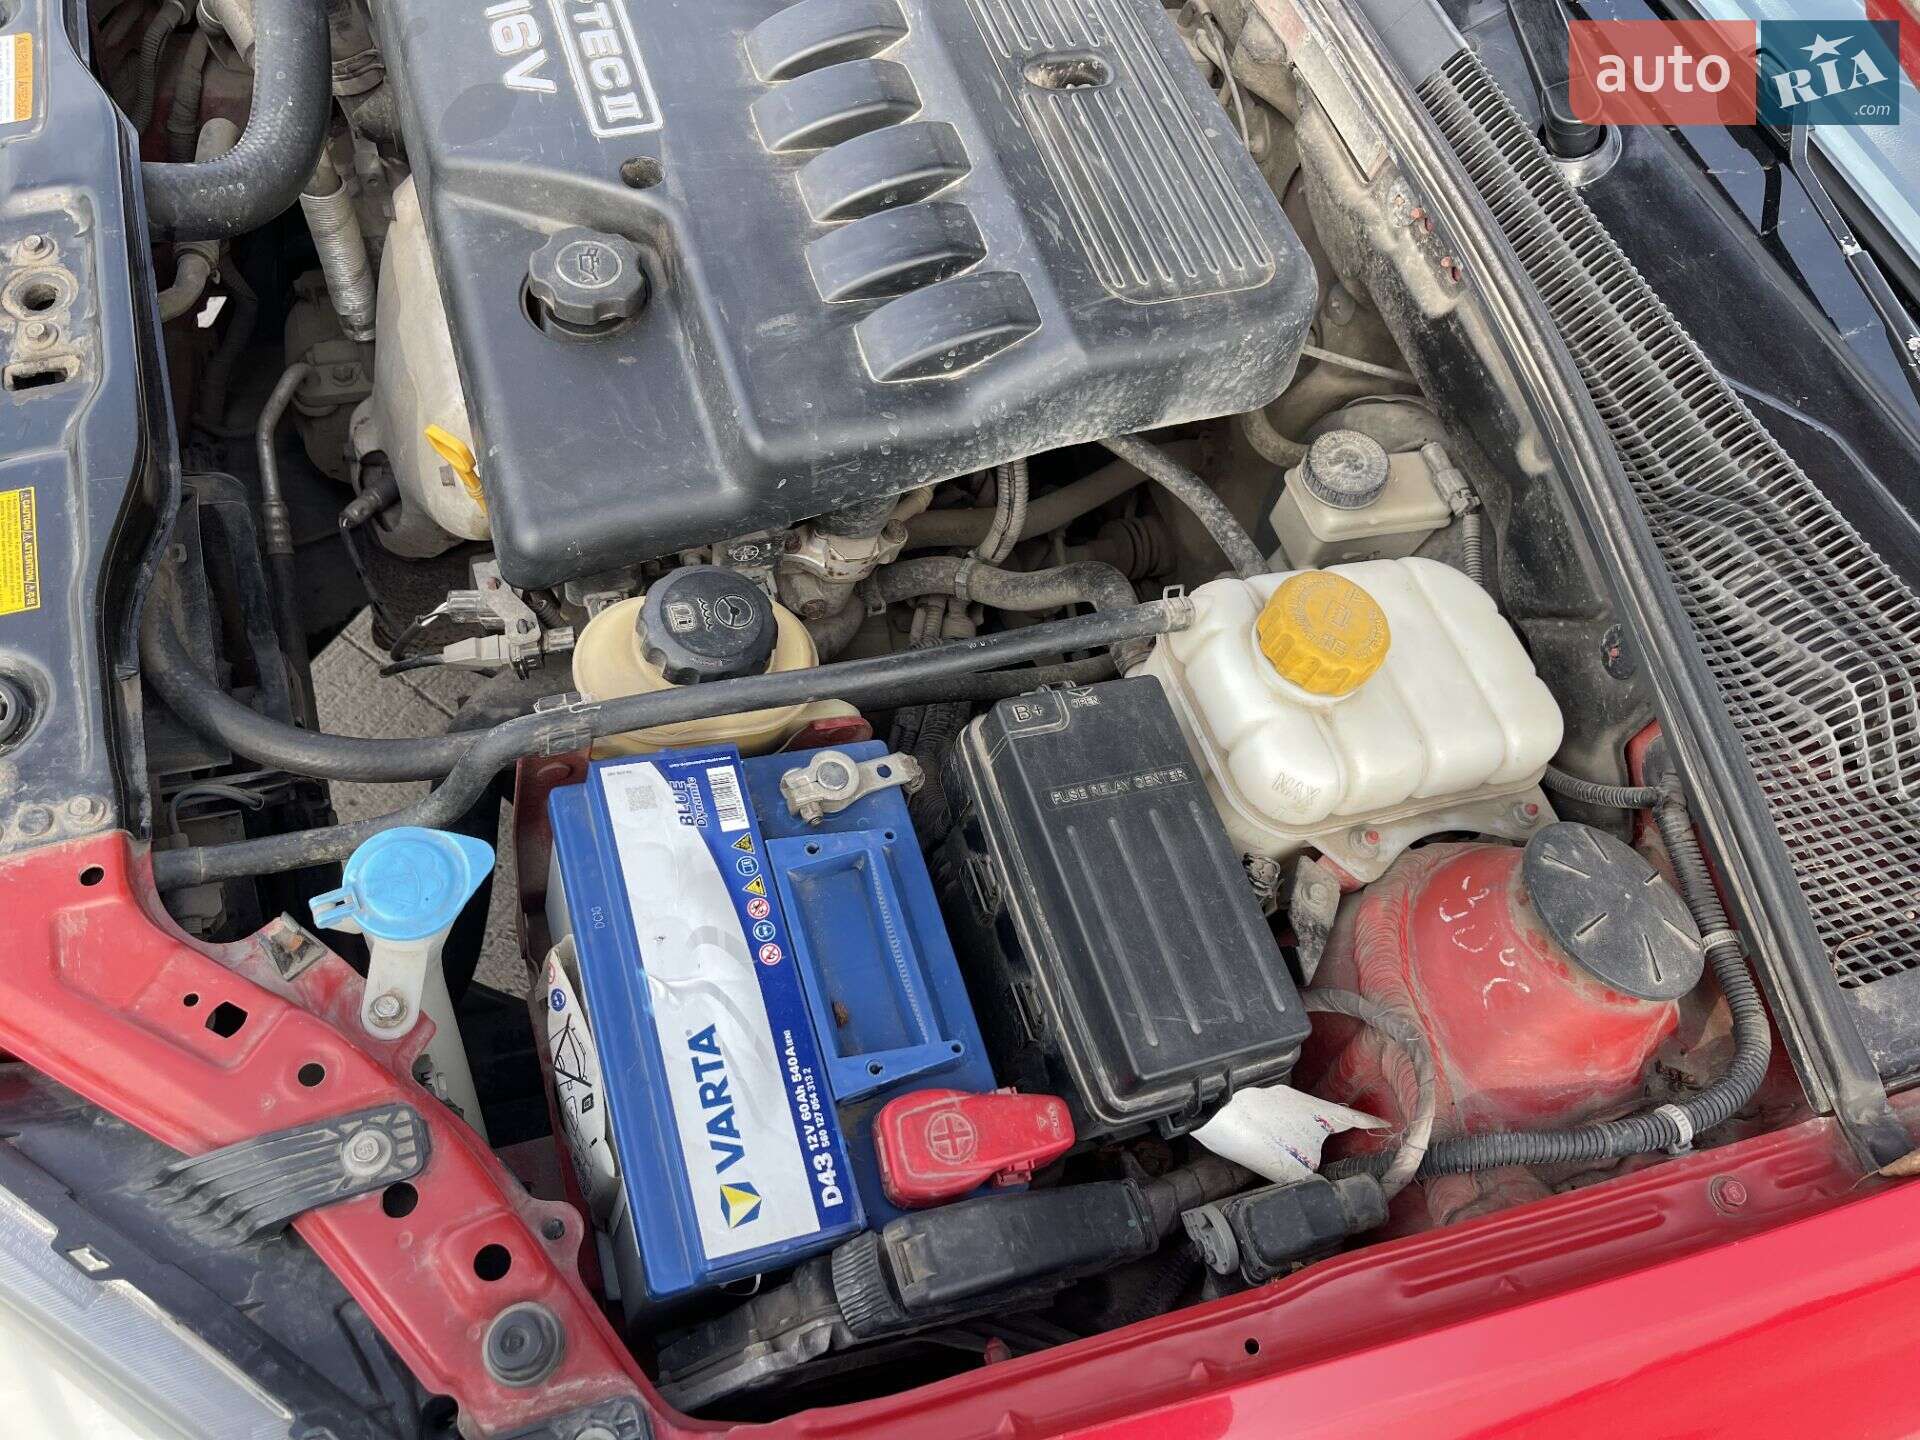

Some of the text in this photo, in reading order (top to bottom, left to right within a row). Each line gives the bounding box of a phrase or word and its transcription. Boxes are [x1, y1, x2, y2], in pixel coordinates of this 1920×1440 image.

[1012, 704, 1043, 723] B+
[1071, 696, 1102, 709] OPEN
[670, 780, 695, 826] BLUE
[687, 776, 709, 827] Dynamic
[1051, 768, 1188, 805] FUSE RELAY CENTER
[687, 1023, 745, 1174] VARTA
[804, 1075, 816, 1092] 313
[795, 1084, 812, 1121] 60Ah
[813, 1111, 825, 1128] 127
[803, 1124, 820, 1151] 12V
[812, 1152, 843, 1208] D43
